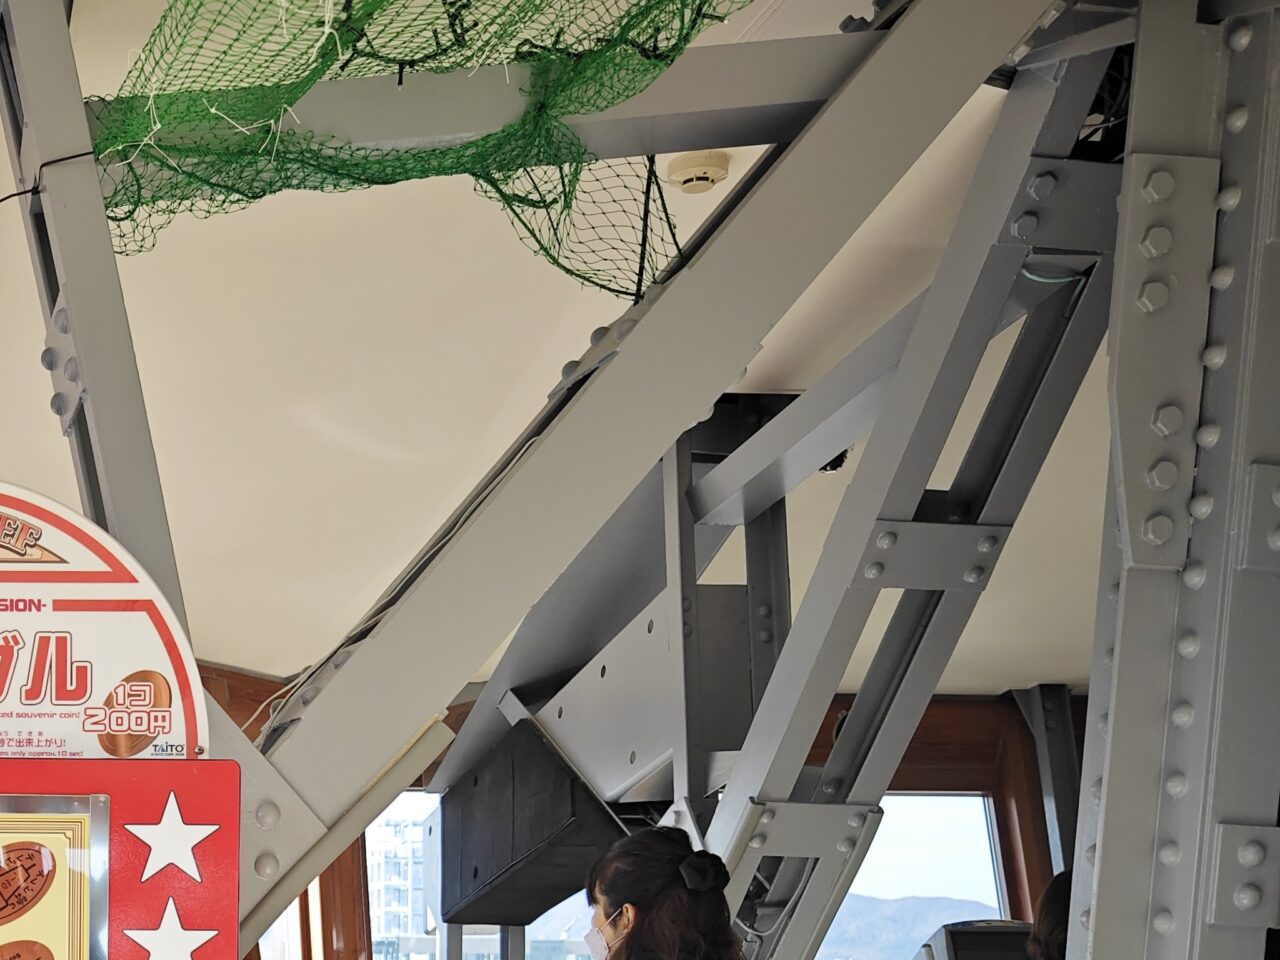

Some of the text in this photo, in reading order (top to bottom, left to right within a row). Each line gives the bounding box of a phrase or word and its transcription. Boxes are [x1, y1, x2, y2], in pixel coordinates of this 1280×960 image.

[114, 684, 152, 706] 1コ
[83, 707, 172, 735] 200円
[152, 742, 185, 752] TAITO
